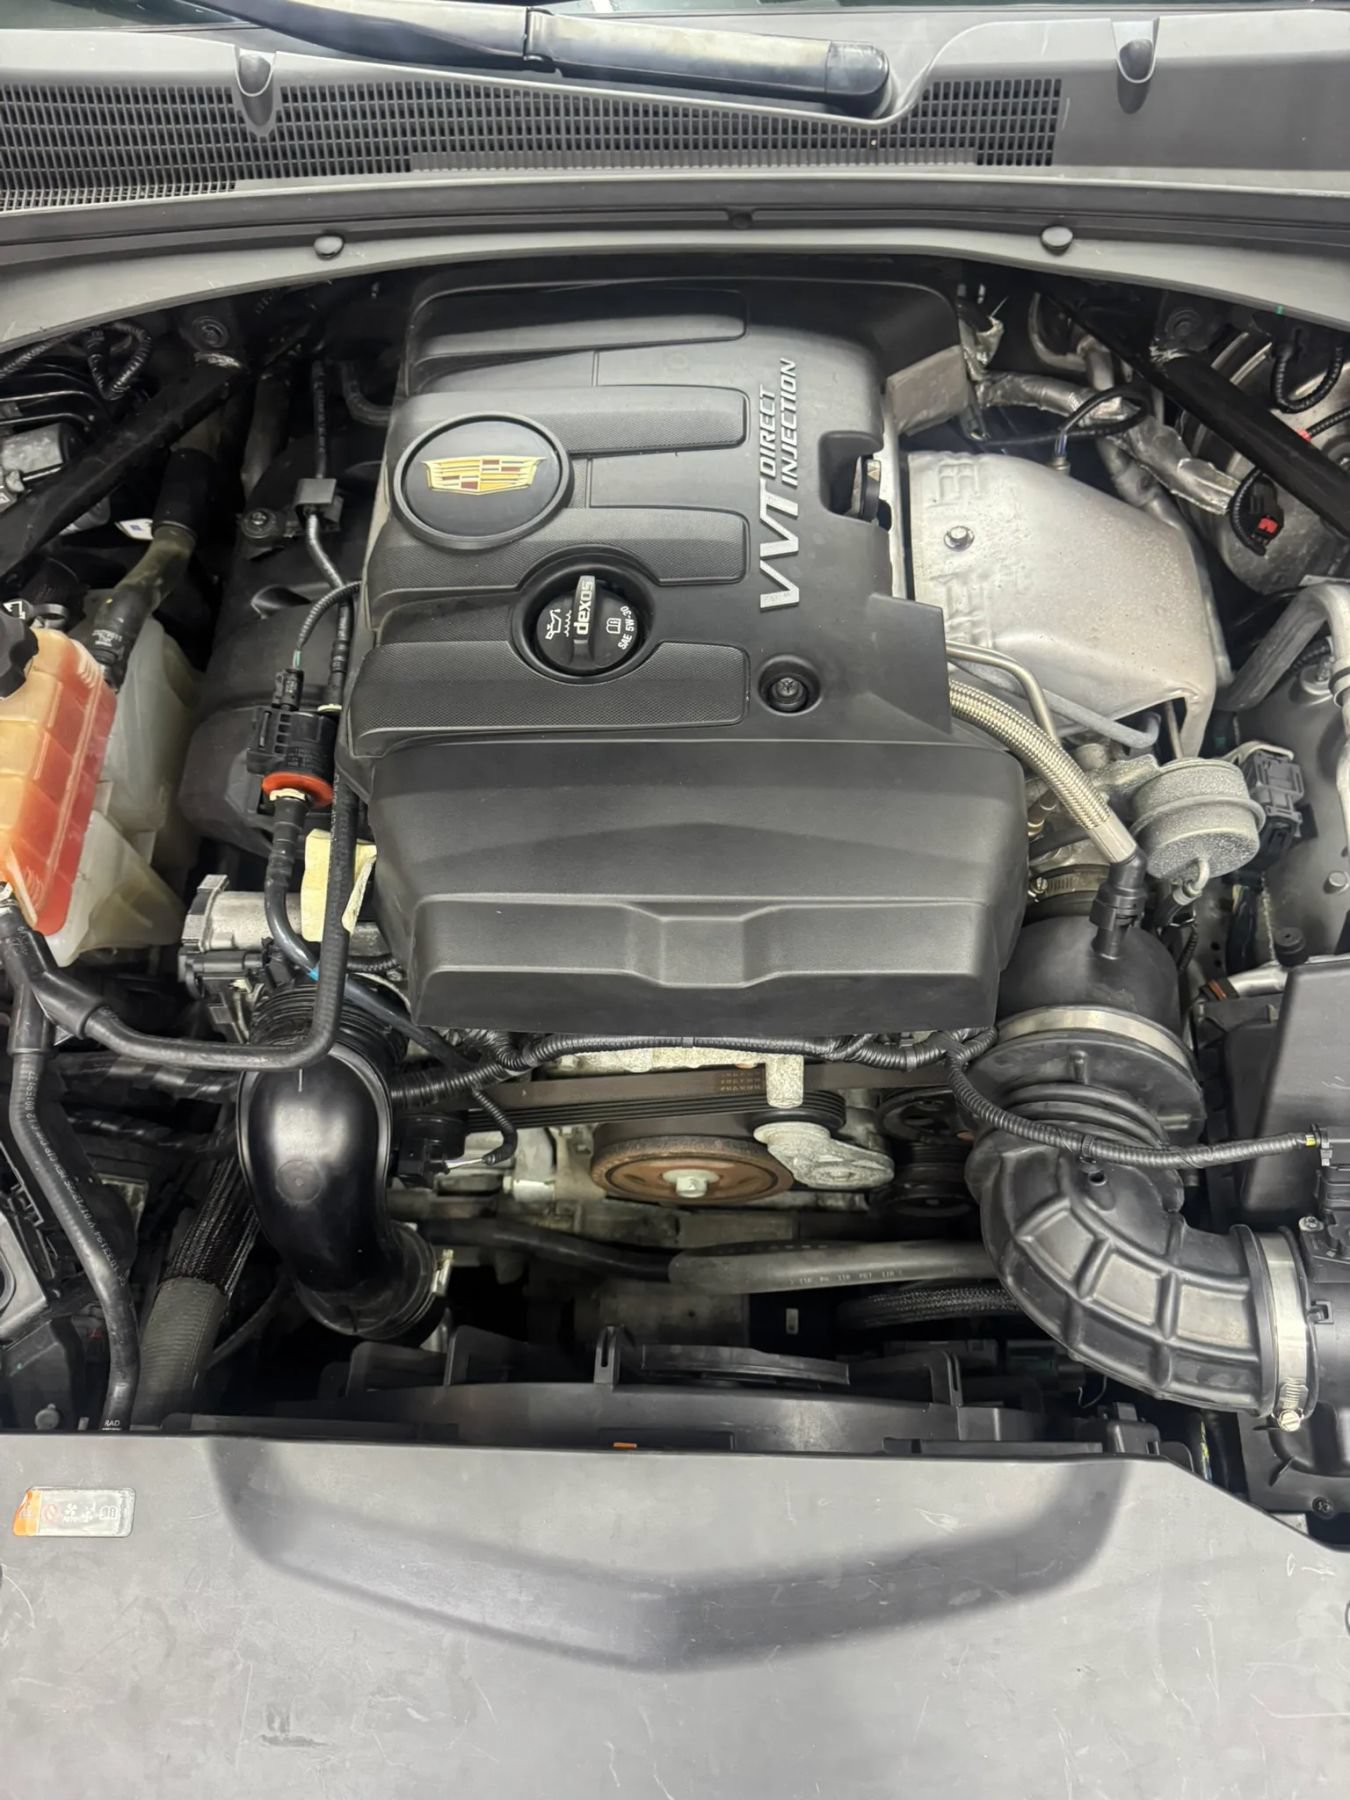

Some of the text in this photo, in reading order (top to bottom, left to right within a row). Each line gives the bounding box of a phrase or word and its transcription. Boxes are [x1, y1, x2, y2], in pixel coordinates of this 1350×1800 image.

[759, 383, 776, 480] DIRECT
[779, 357, 798, 488] INJECTION
[759, 477, 799, 610] VVT
[573, 580, 594, 635] dexos
[617, 605, 635, 650] SAE 5W-30
